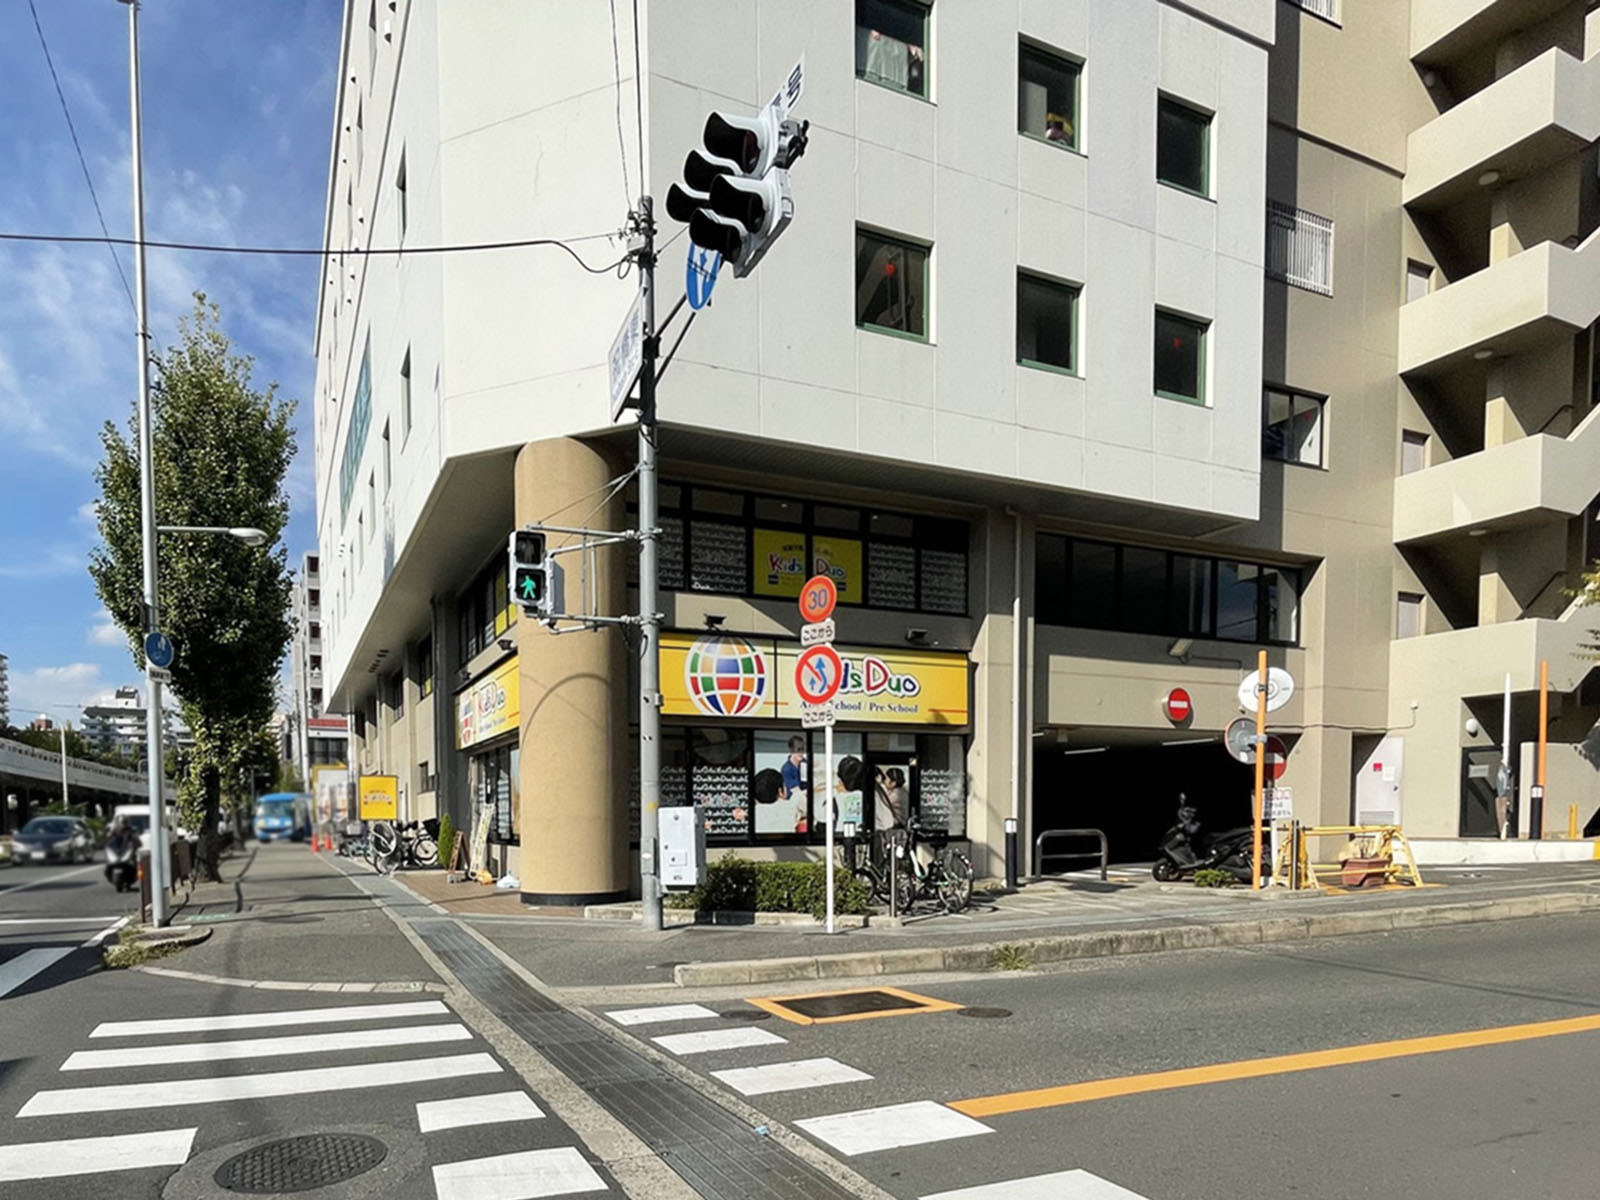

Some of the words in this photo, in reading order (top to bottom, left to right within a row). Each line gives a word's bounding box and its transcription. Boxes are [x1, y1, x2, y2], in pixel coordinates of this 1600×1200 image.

[768, 553, 803, 572] Kids
[815, 558, 845, 577] Duo
[807, 588, 828, 610] 30
[803, 625, 833, 641] ここから
[869, 702, 885, 712] Pre
[887, 703, 918, 713] School
[803, 710, 834, 724] ここから
